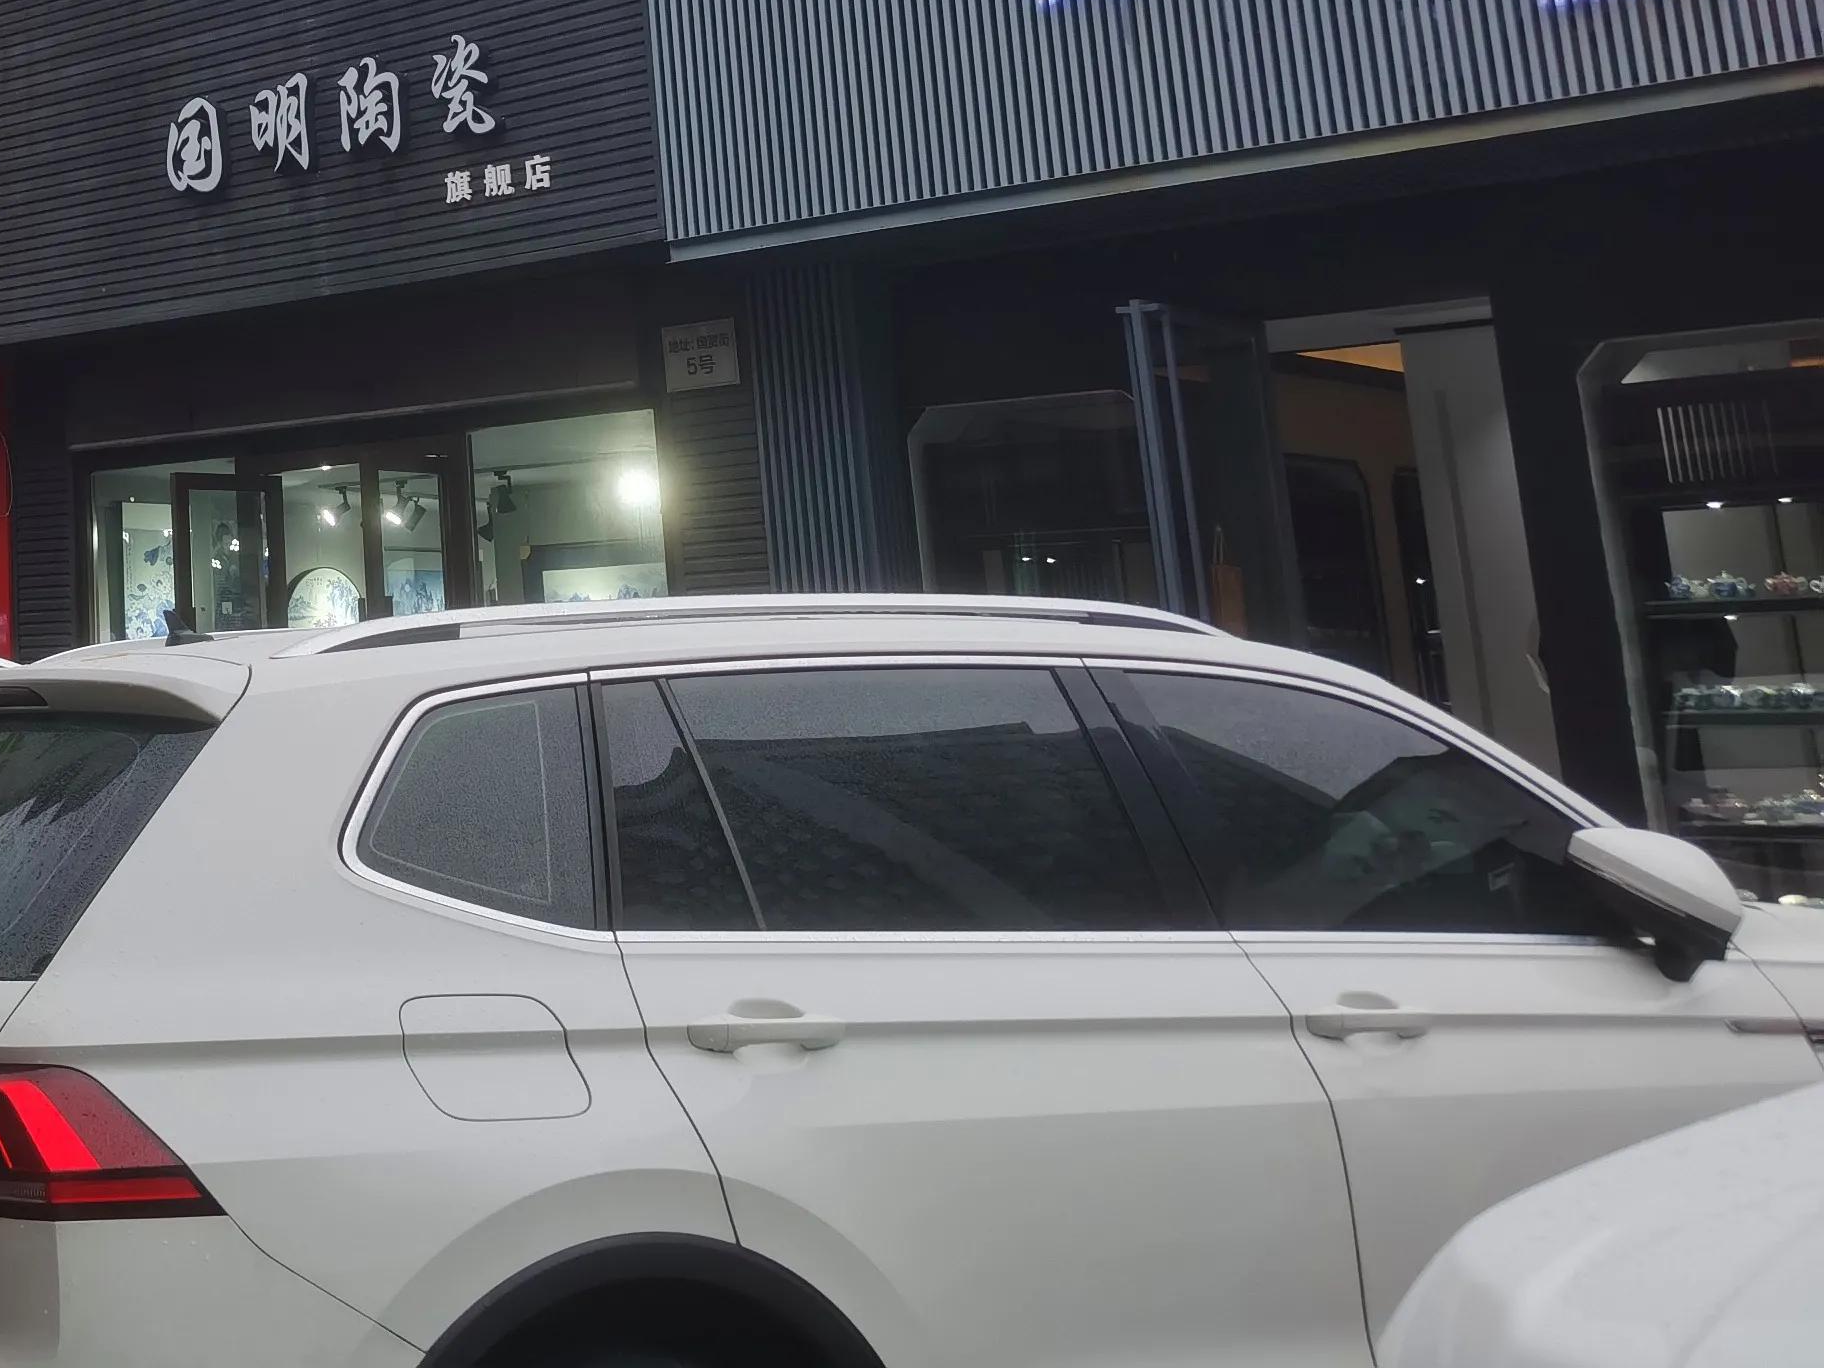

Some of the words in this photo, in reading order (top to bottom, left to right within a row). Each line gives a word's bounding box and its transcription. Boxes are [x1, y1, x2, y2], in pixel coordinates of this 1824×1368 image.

[166, 34, 498, 193] 国明陶瓷
[444, 154, 552, 204] 旗舰店
[687, 355, 716, 375] 5号
